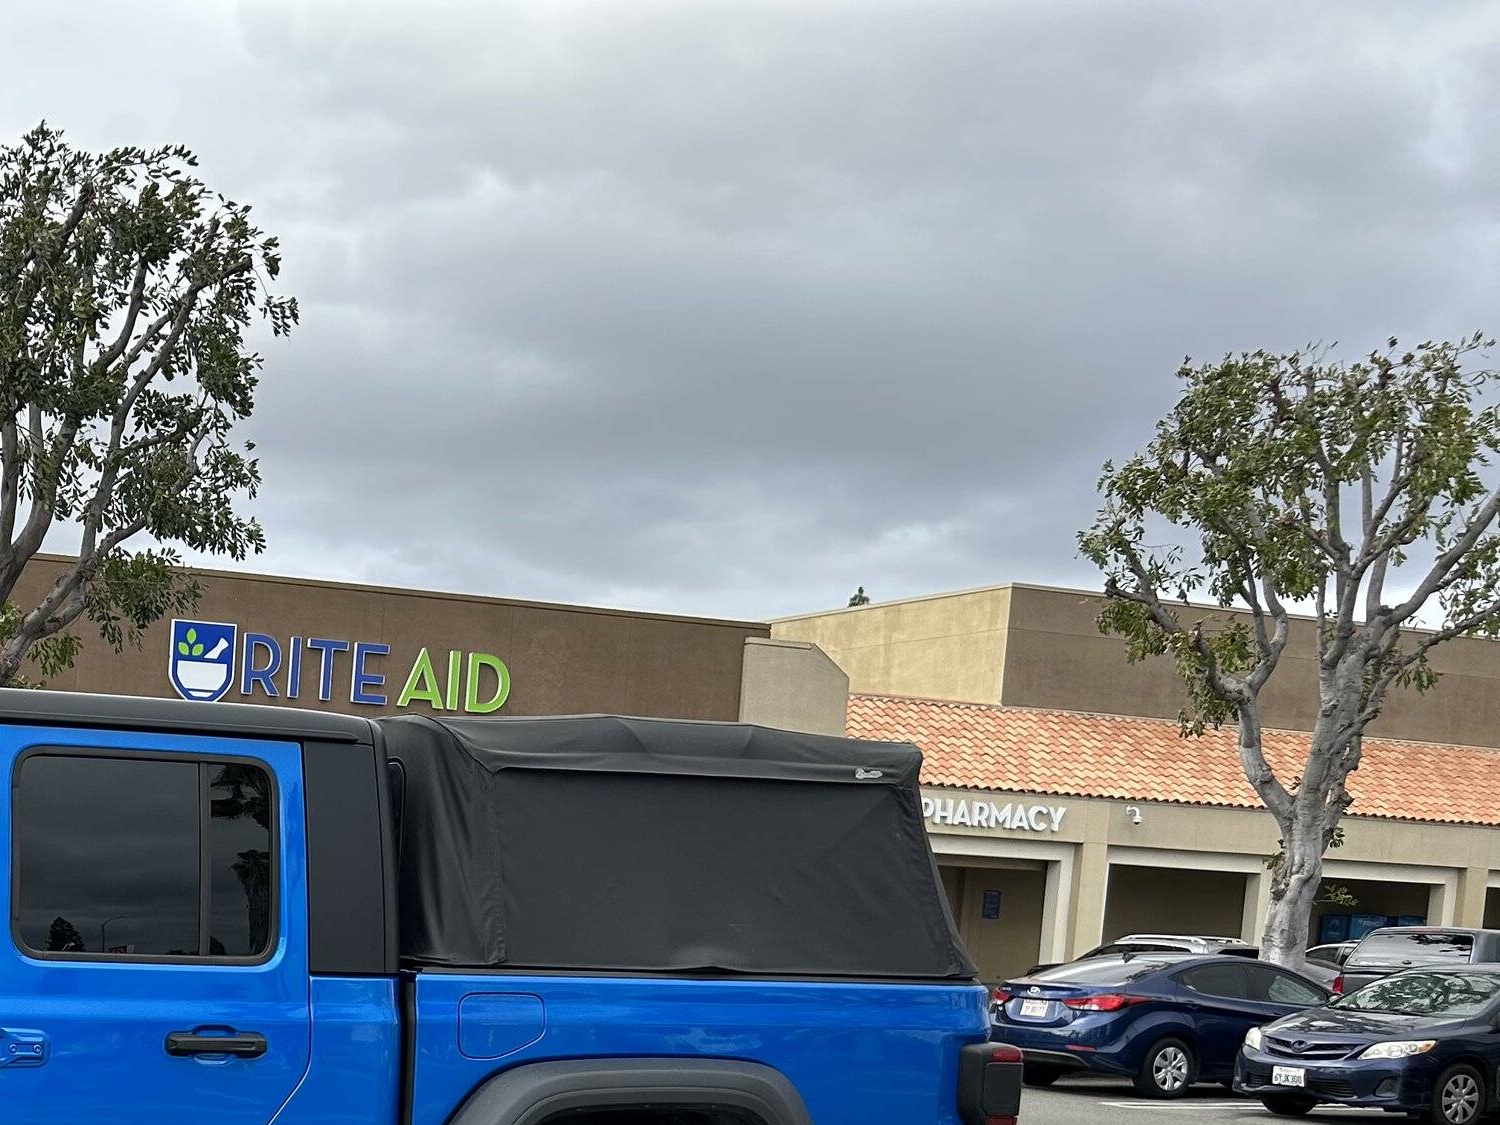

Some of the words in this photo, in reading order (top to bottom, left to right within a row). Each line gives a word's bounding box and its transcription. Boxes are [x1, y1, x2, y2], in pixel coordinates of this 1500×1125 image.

[240, 632, 391, 706] RITE
[396, 647, 511, 714] AID
[921, 796, 1066, 833] PHARMACY
